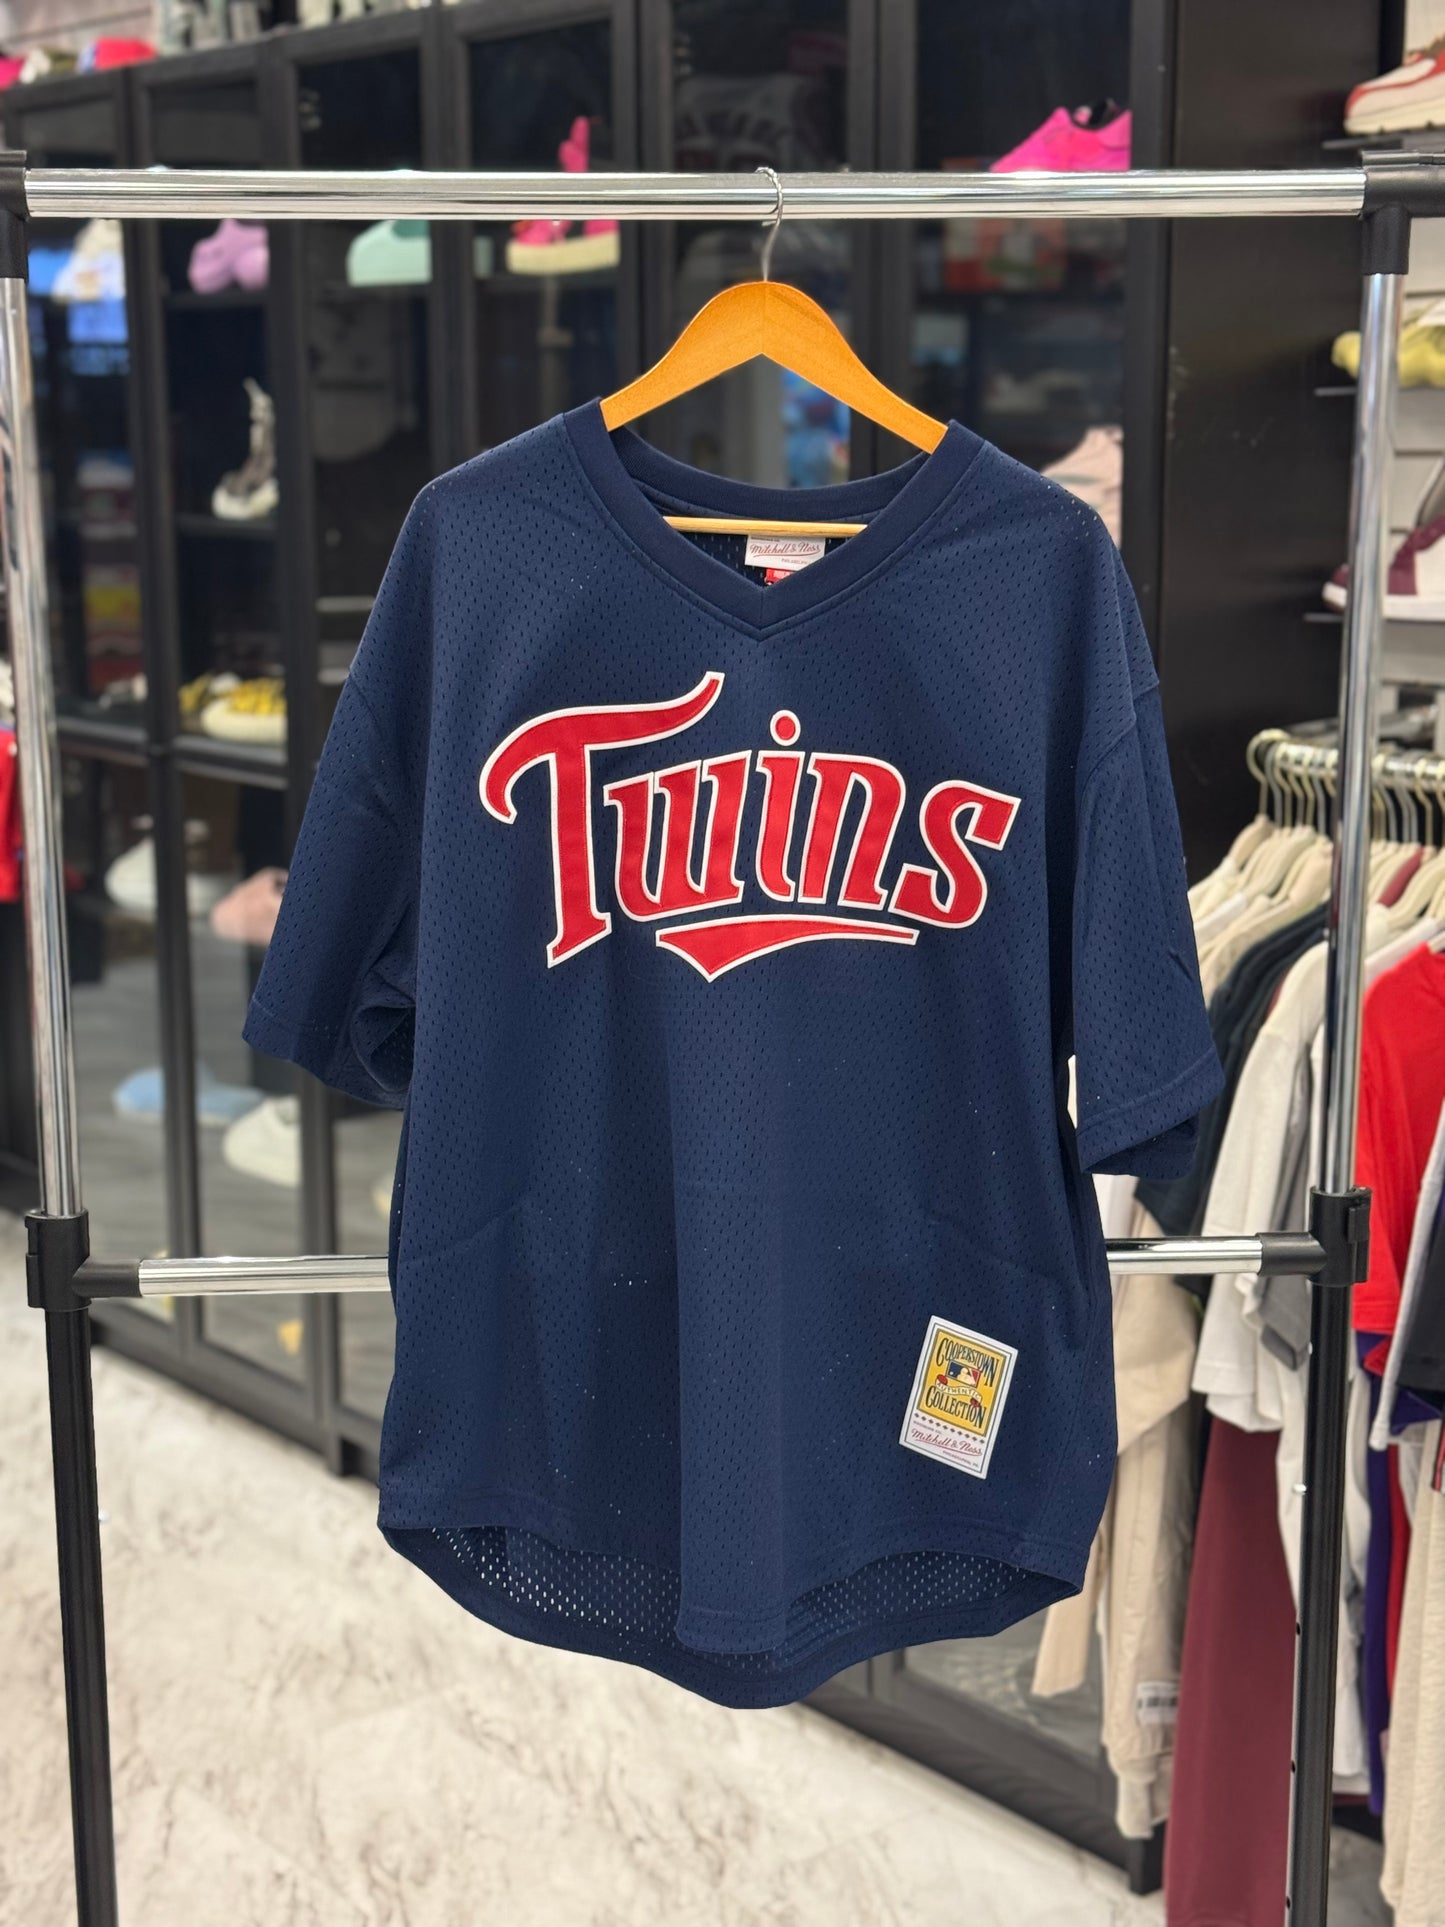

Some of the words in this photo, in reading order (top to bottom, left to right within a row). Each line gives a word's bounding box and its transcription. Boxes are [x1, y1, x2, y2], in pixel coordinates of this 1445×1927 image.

[749, 543, 790, 554] Mitchell
[790, 543, 797, 553] &
[797, 541, 821, 552] Ness
[479, 671, 1021, 969] Twins
[936, 1337, 1000, 1388] COOPERSTOWN
[925, 1385, 987, 1429] COLLECTION
[911, 1427, 951, 1447] Mitchell
[951, 1440, 959, 1449] &
[959, 1440, 982, 1455] Ness
